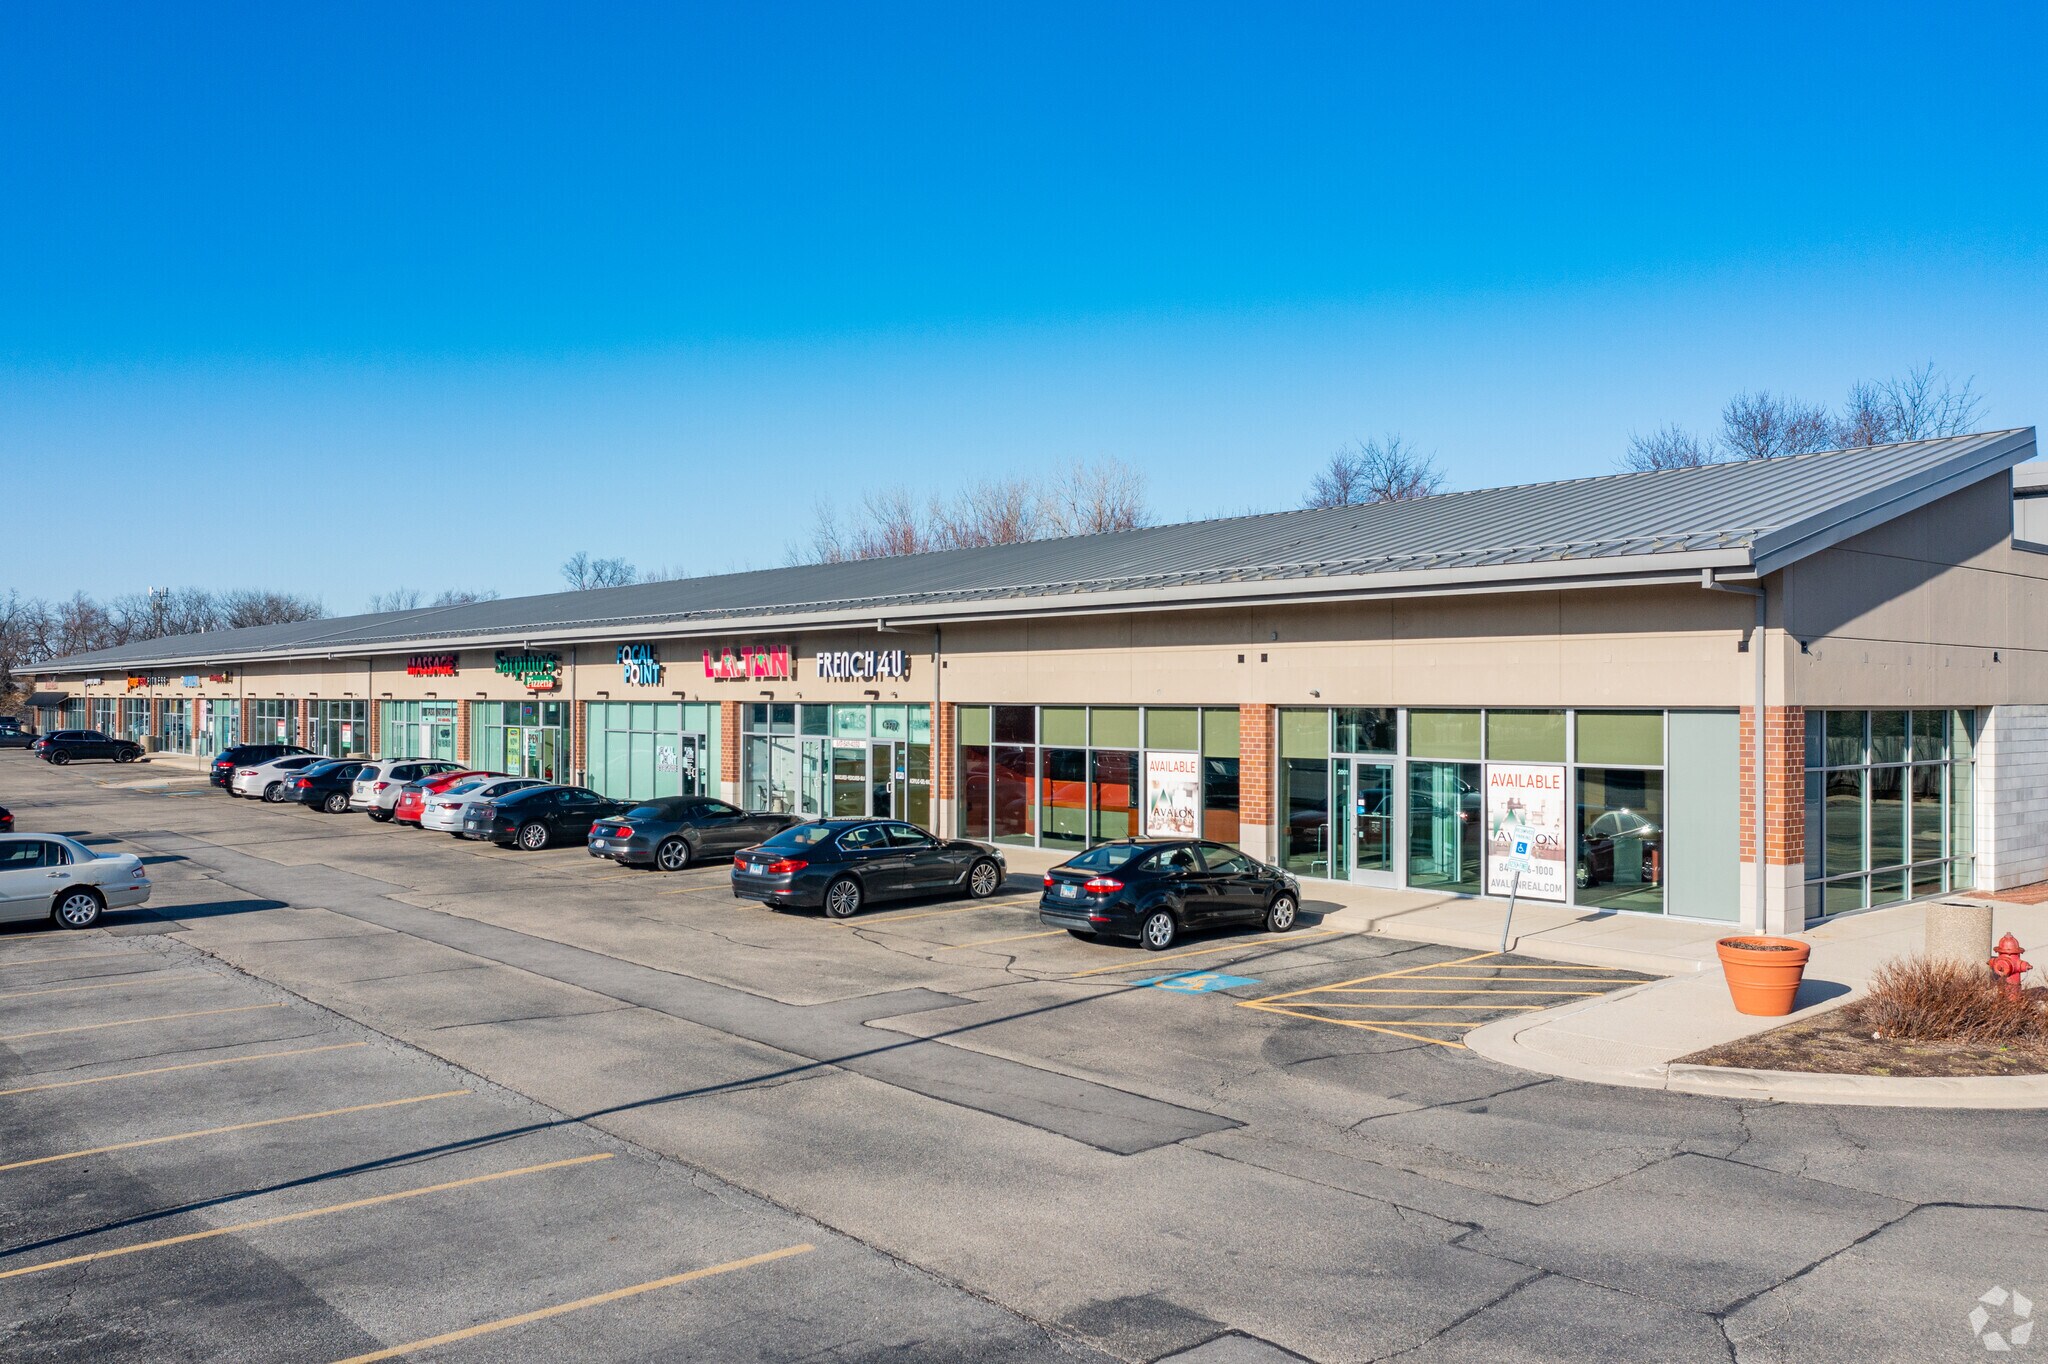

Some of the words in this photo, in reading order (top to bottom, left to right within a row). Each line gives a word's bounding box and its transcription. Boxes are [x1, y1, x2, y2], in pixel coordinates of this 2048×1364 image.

[617, 645, 653, 664] FOCAL
[816, 650, 874, 677] FRENCH
[876, 650, 902, 677] 4U
[407, 656, 454, 675] MASSAGE
[495, 651, 555, 681] Sarpino's
[624, 663, 660, 684] POINT
[526, 677, 553, 688] Pizzeria
[1150, 760, 1196, 773] AVAILABLE
[1491, 773, 1560, 789] AVAILABLE
[1153, 808, 1195, 819] AVALON
